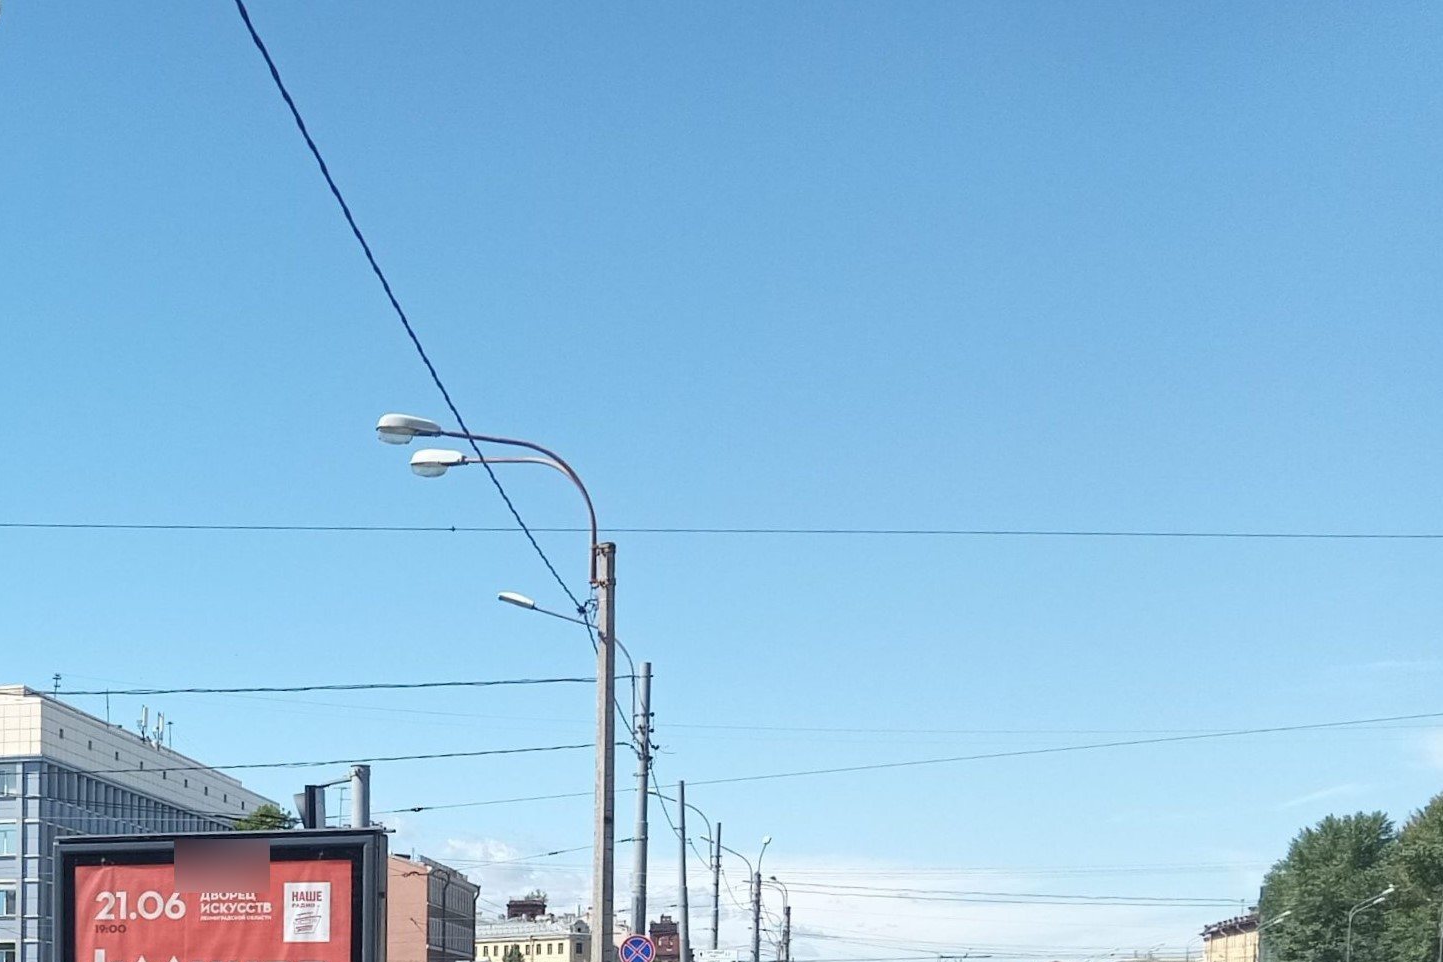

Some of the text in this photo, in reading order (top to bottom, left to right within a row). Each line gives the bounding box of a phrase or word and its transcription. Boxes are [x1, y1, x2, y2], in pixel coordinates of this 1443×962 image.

[292, 891, 322, 901] НАШЕ
[94, 890, 186, 921] 21.06
[200, 902, 272, 914] ИСКУССТВ
[94, 924, 127, 934] 19:00
